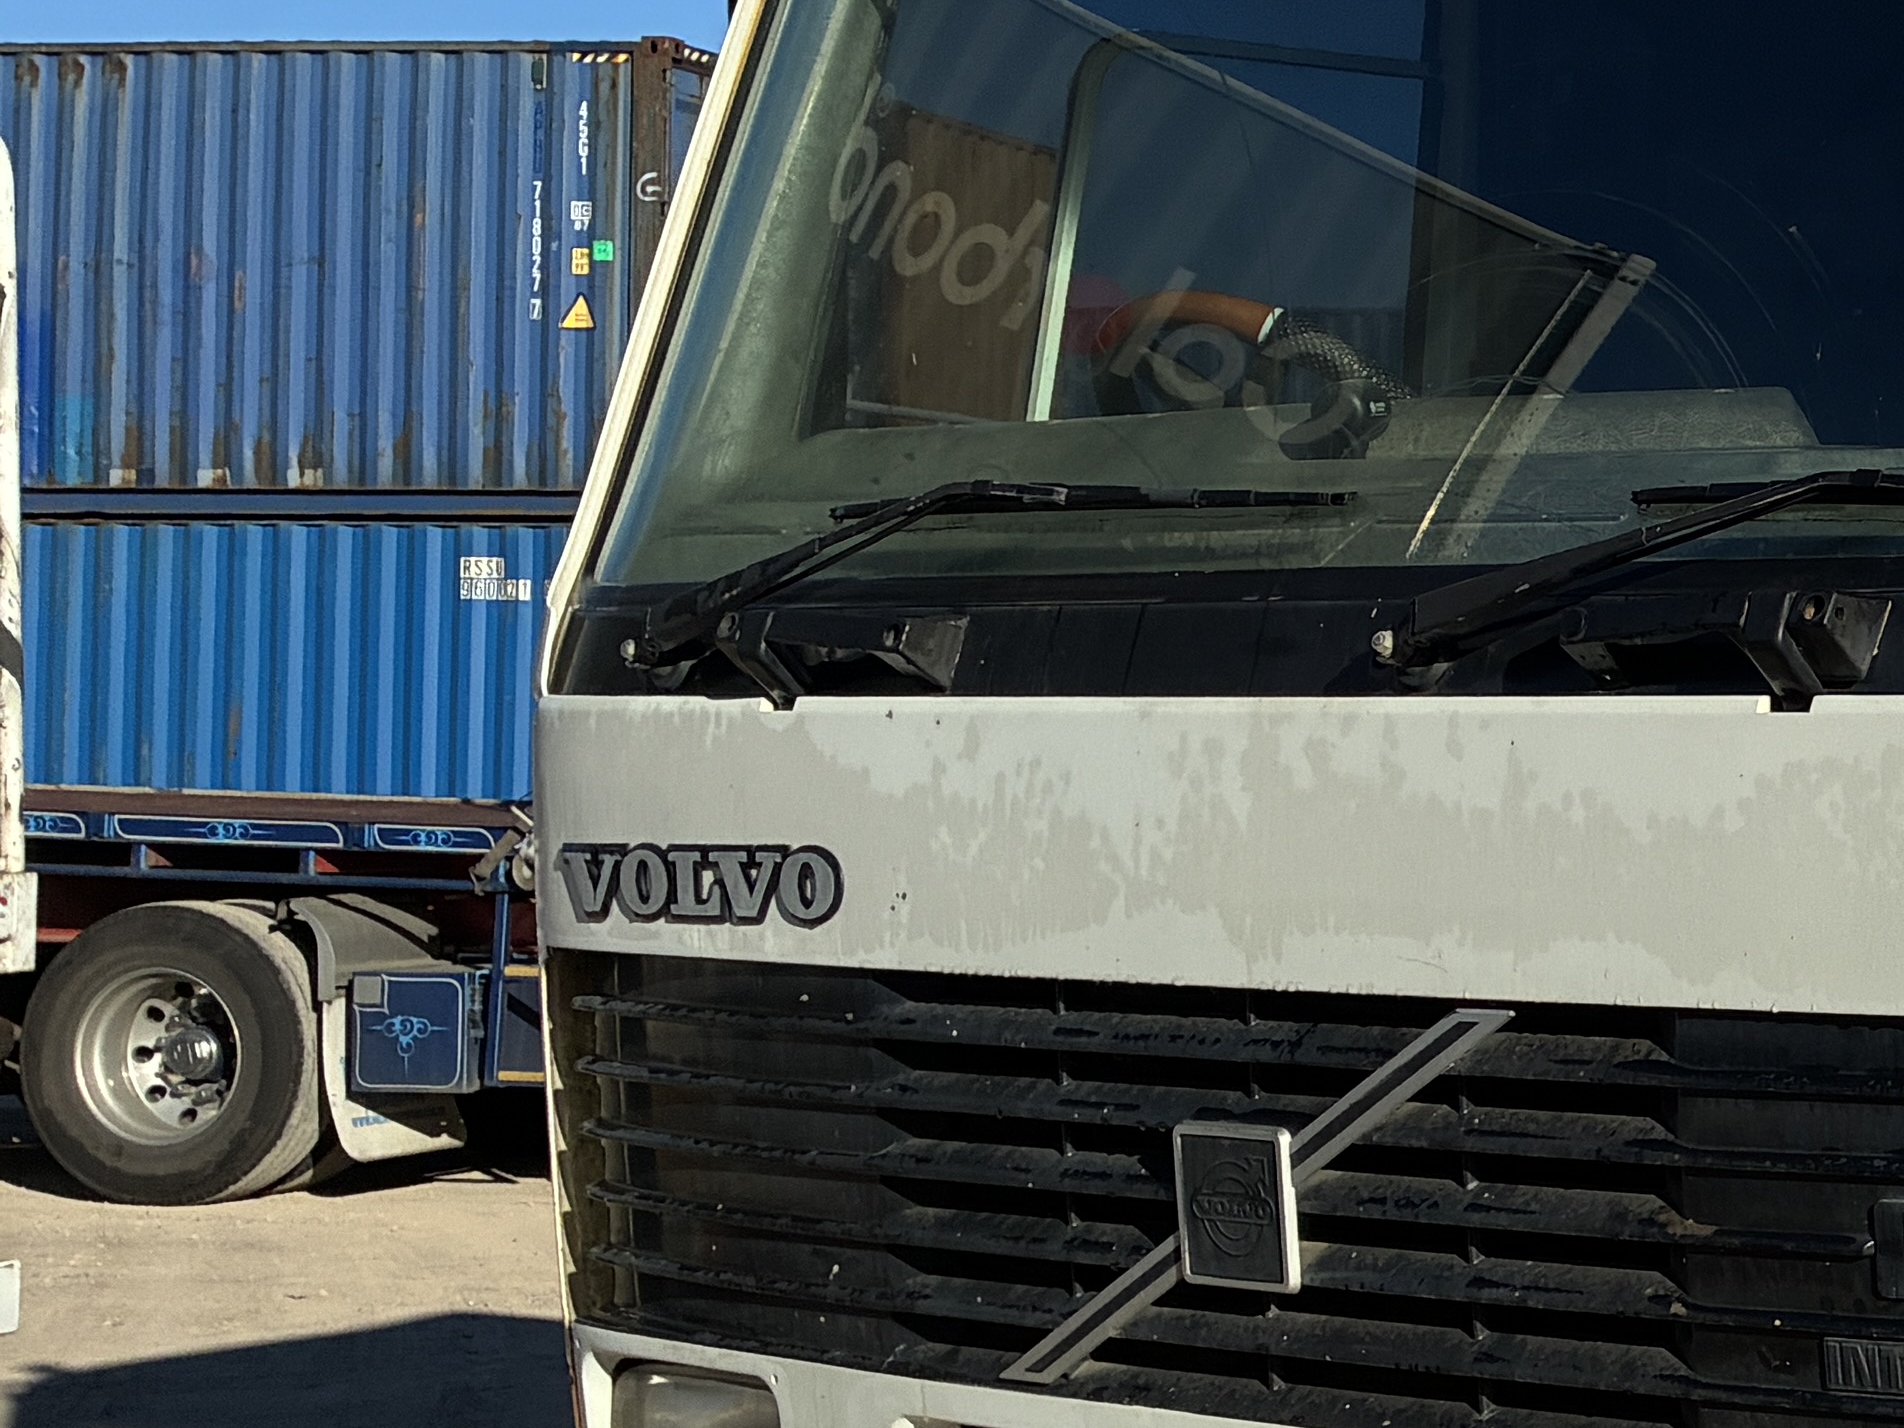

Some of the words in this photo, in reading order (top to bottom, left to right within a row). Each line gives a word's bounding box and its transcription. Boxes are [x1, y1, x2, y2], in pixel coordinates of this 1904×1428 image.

[579, 101, 588, 175] 45G1
[532, 181, 542, 291] 718027
[531, 299, 542, 319] 7
[463, 559, 503, 576] RSSU
[558, 843, 844, 928] VOLVO
[1196, 1197, 1272, 1220] VOLVO
